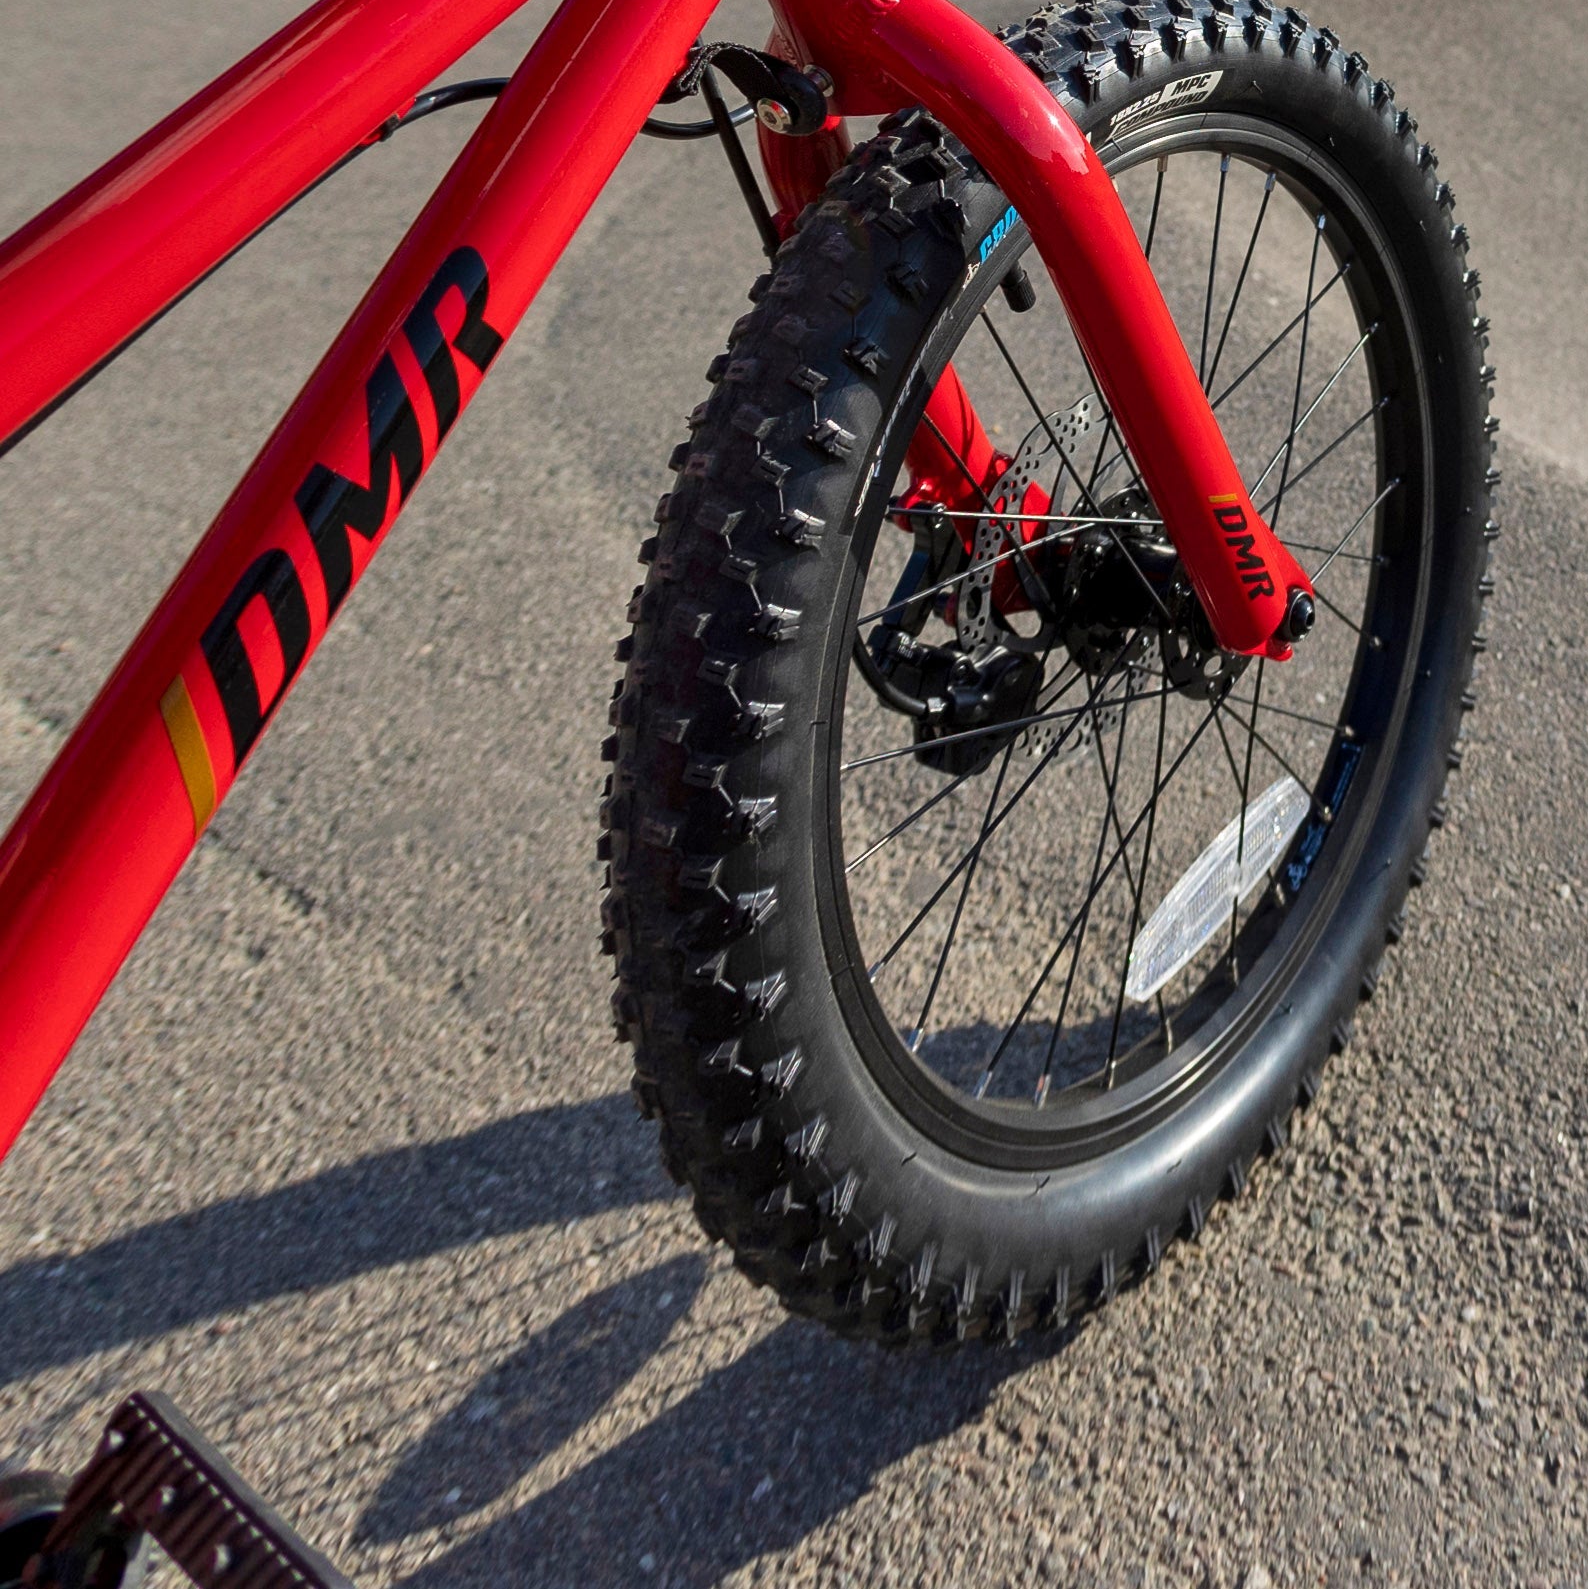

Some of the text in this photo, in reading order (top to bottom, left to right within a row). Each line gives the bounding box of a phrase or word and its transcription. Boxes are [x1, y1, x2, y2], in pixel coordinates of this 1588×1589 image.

[1117, 90, 1209, 131] COMPOUND
[1170, 74, 1212, 97] MPC
[200, 246, 504, 774] DMR
[1213, 505, 1275, 601] DMR
